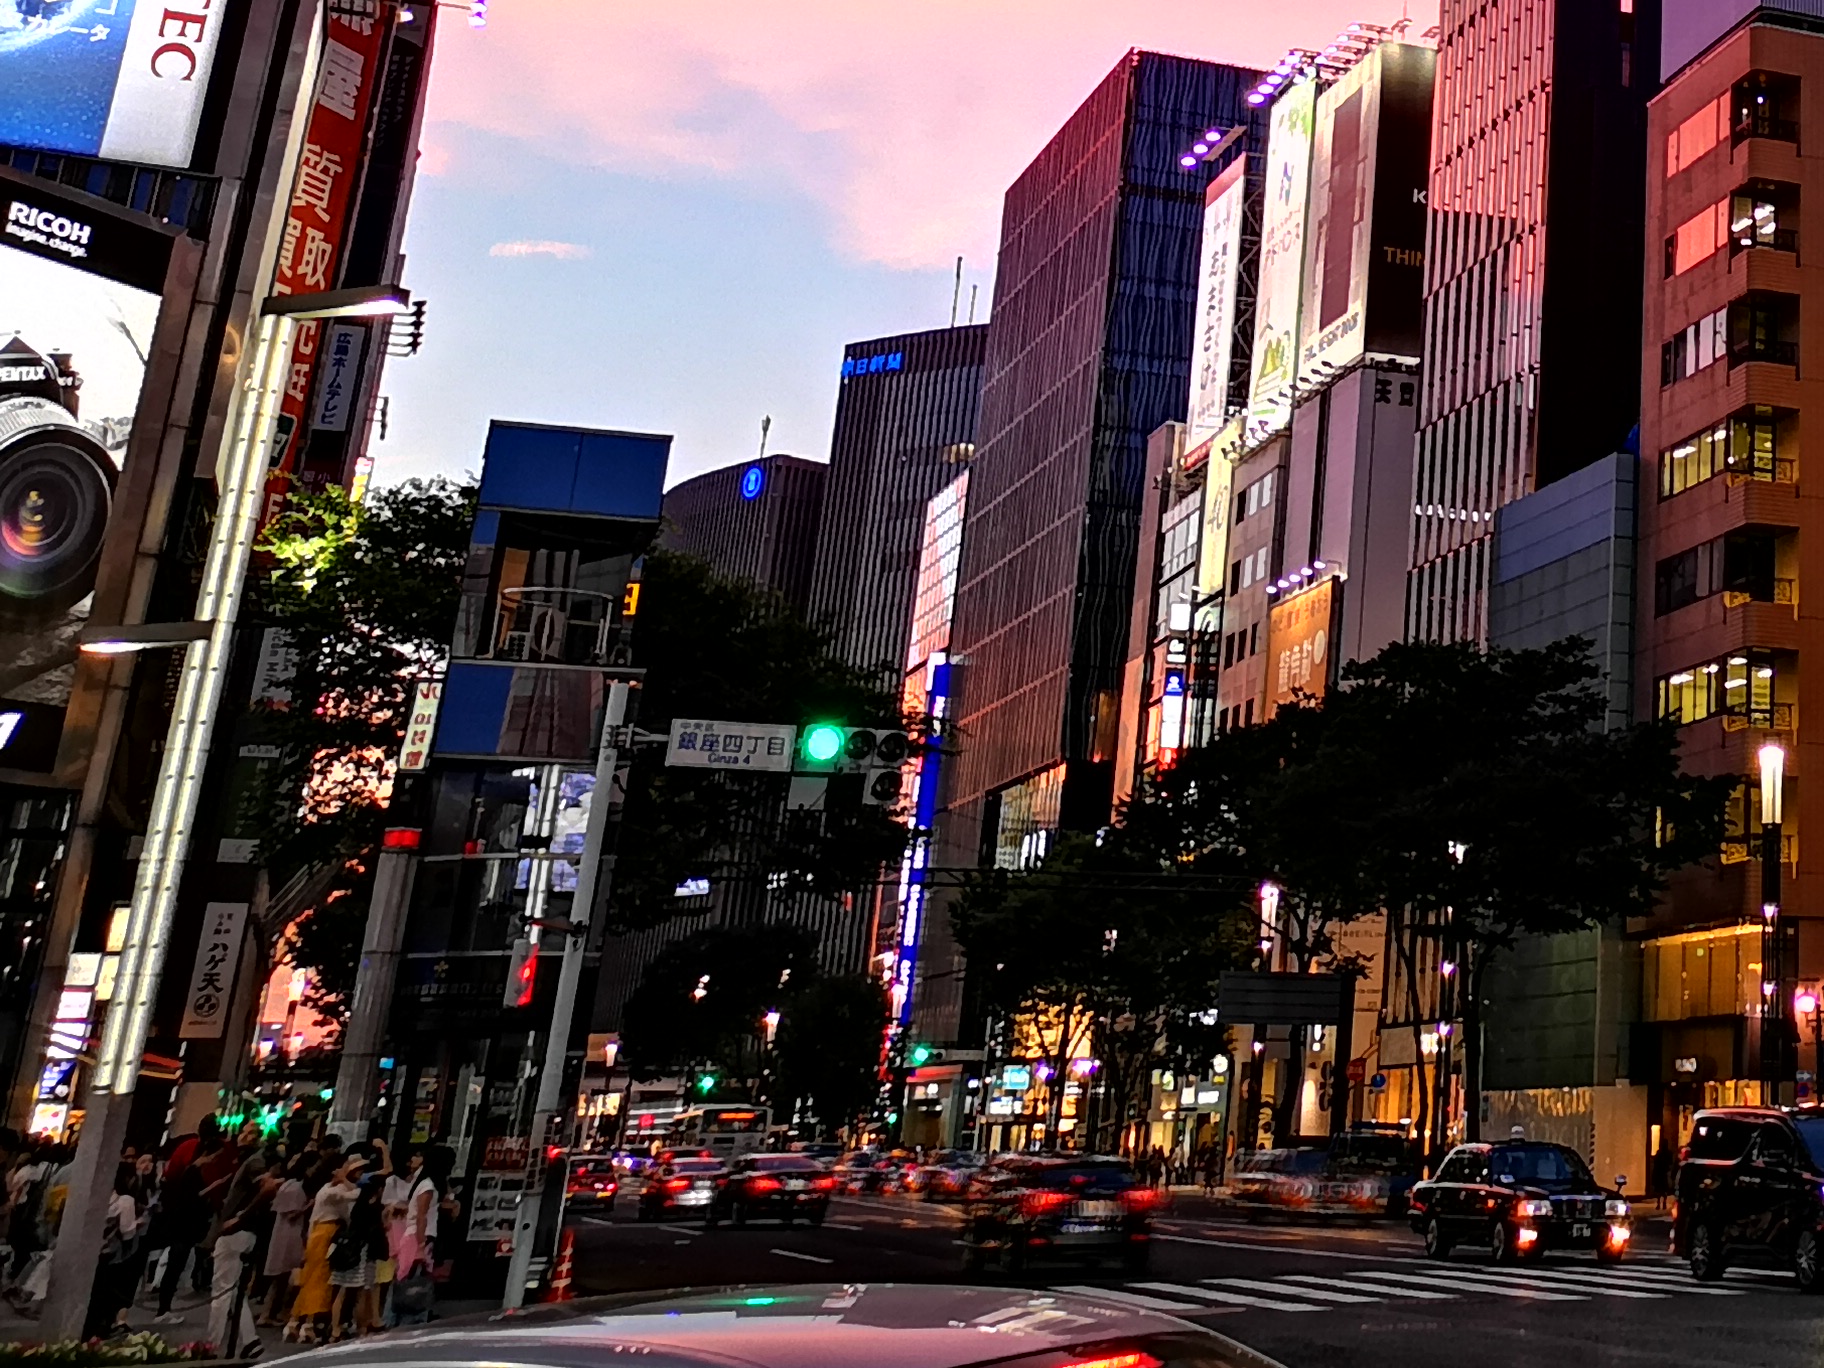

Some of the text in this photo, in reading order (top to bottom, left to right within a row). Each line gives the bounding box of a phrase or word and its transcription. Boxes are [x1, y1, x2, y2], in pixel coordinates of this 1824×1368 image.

[293, 143, 342, 222] 質
[8, 201, 91, 244] RICOH
[677, 731, 786, 756] 銀座四丁目
[707, 752, 751, 765] Ginza 4
